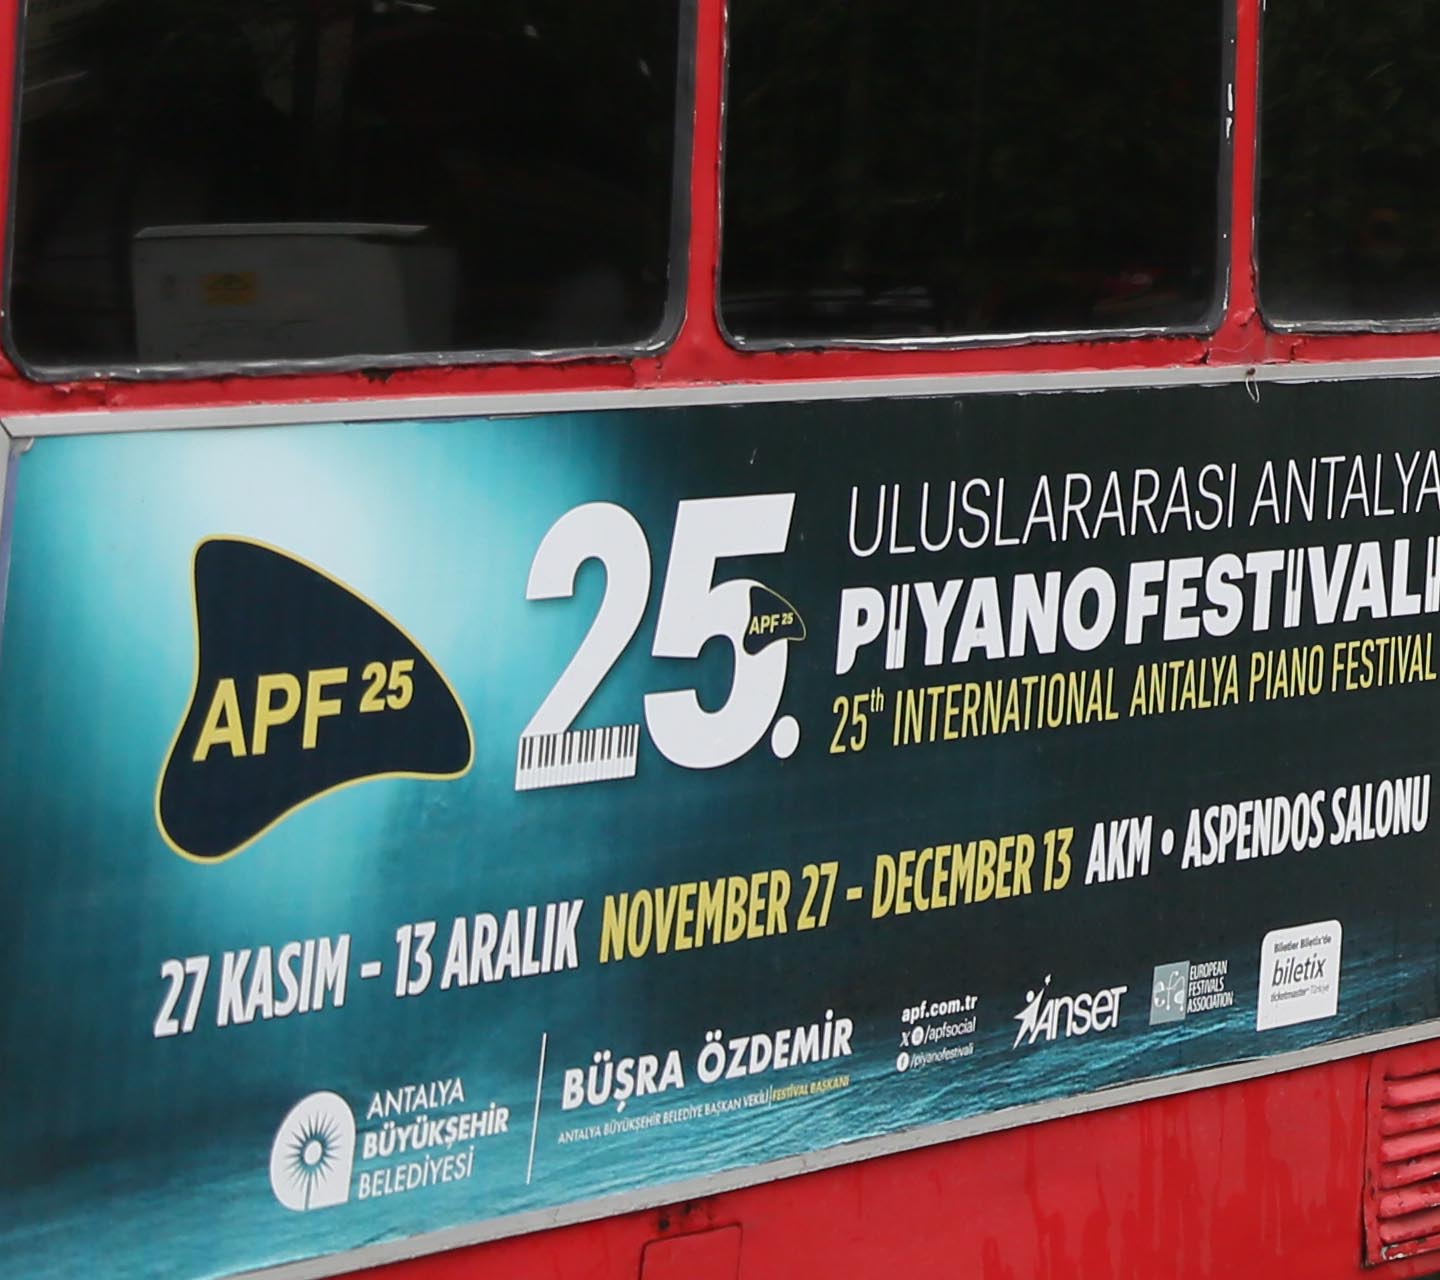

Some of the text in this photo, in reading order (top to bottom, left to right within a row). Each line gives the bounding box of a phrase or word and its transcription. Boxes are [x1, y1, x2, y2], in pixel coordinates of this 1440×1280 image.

[847, 462, 1237, 557] ULUSLARARASI
[518, 491, 801, 792] 25.
[749, 612, 795, 636] APF 25
[193, 658, 416, 763] APF 25
[829, 632, 1438, 755] 25th INTERNATIONAL ANTALYA PIANO FESTIVAL
[153, 954, 209, 1038] 27
[217, 934, 351, 1028] KASIM
[394, 921, 437, 997] 13
[440, 899, 584, 991] ARALIK
[599, 867, 790, 963] NOVEMBER
[796, 861, 839, 932] 27
[871, 833, 1037, 922] DECEMBER
[1040, 826, 1075, 892] 13
[1084, 813, 1155, 887] AKM
[1180, 788, 1327, 871] ASPENDOS
[1328, 773, 1434, 849] SALONU
[1188, 976, 1225, 997] FESTIVALS
[1189, 959, 1229, 980] EUROPEAN
[1271, 952, 1327, 987] biletix
[901, 994, 978, 1025] apf.com.tr
[1187, 991, 1234, 1014] ASSOCIATION
[561, 1009, 854, 1114] BÜŞRA ÖZDEMİR
[366, 1076, 466, 1121] ANTALYA
[558, 1125, 602, 1145] ANTALYA
[603, 1114, 662, 1137] BÜYÜKŞEHİR
[663, 1104, 703, 1126] BELEDİYE
[704, 1097, 743, 1119] BAŞKAN
[362, 1101, 510, 1160] BÜYÜKŞEHİR
[358, 1145, 476, 1200] BELEDİYESİ
